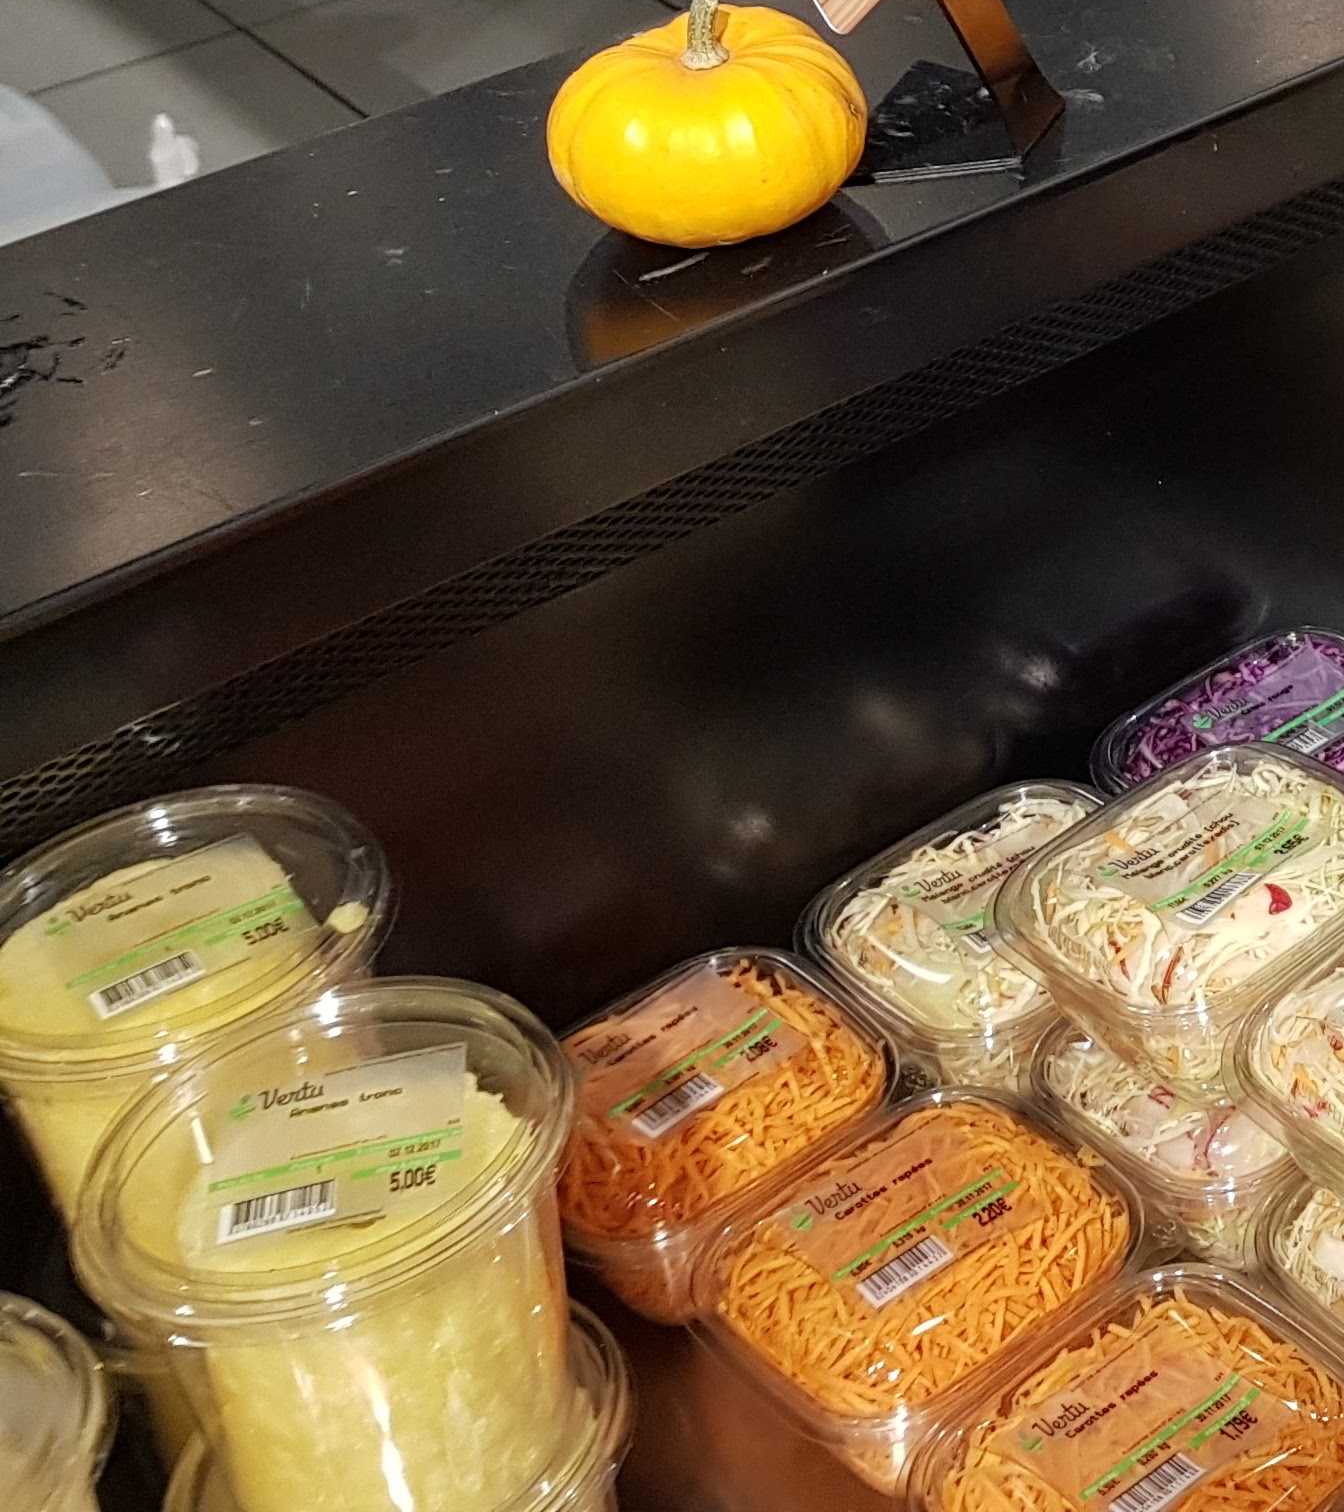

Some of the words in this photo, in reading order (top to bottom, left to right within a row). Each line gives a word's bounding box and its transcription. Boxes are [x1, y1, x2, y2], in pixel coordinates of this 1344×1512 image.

[1205, 697, 1249, 720] Vertu
[914, 870, 963, 892] Vertu
[259, 1080, 325, 1110] Vertu
[804, 1182, 862, 1216] Vertu
[835, 1186, 888, 1221] Carottes
[892, 1158, 932, 1185] rapées
[1032, 1402, 1091, 1437] Vertu
[1065, 1402, 1116, 1439] Carottes
[1120, 1370, 1158, 1401] rapées
